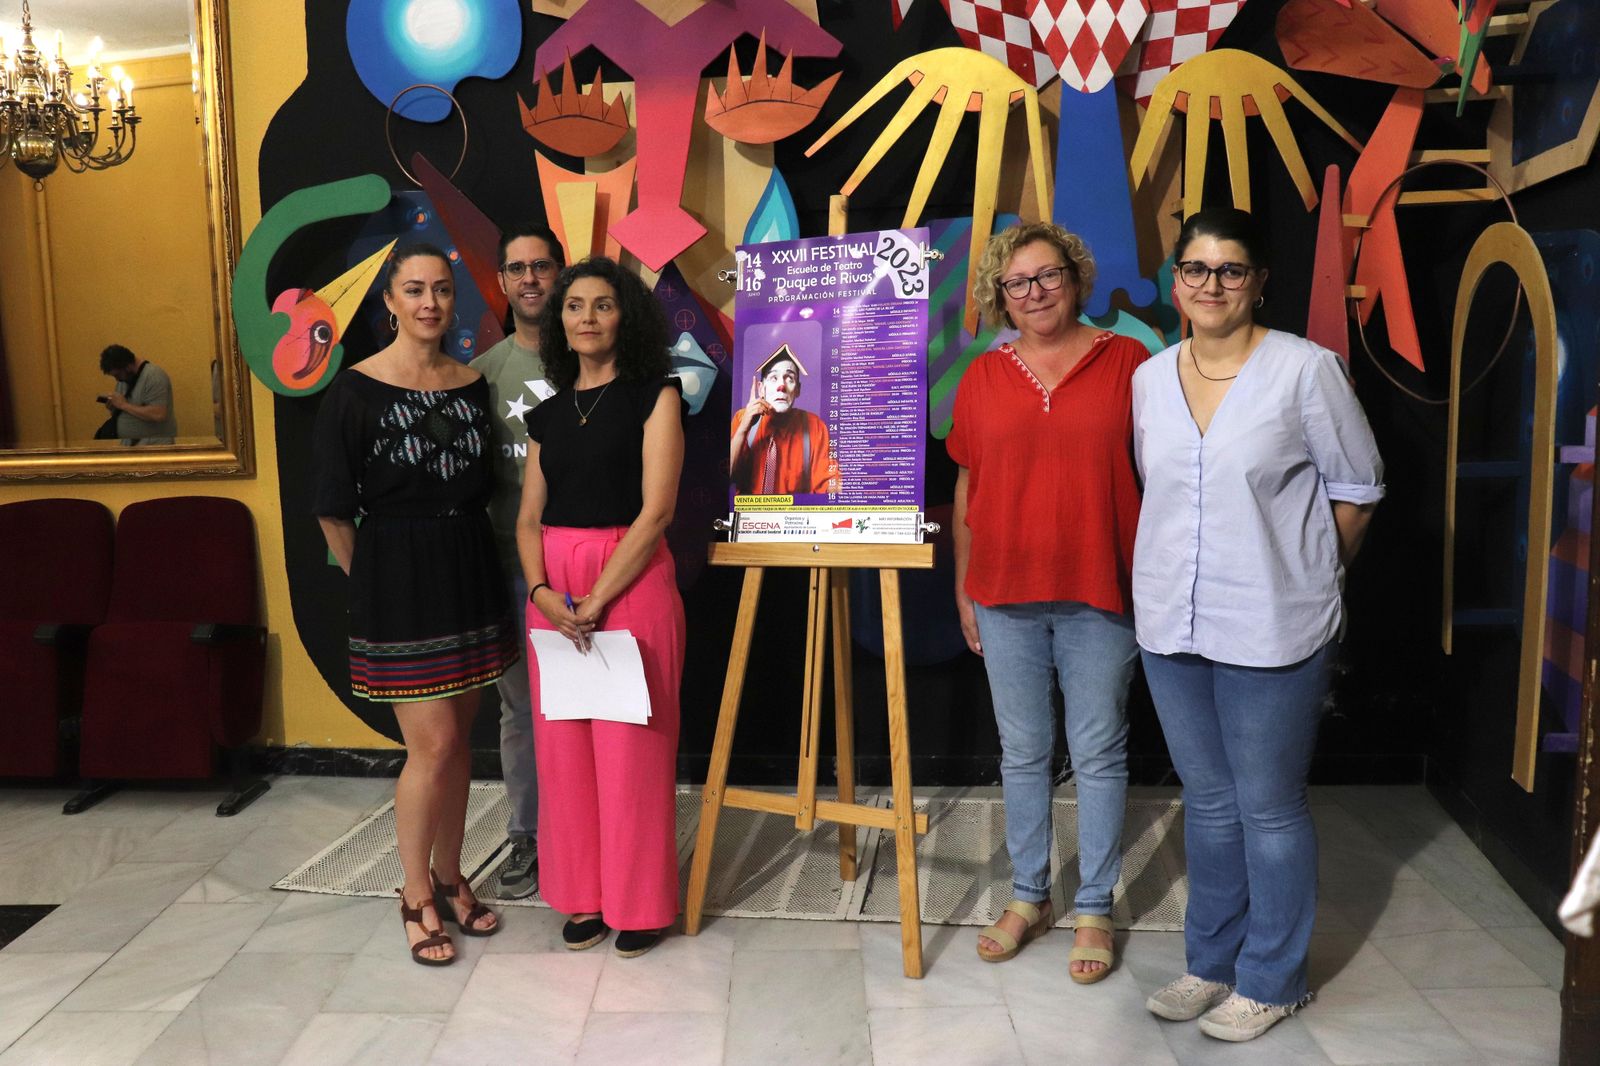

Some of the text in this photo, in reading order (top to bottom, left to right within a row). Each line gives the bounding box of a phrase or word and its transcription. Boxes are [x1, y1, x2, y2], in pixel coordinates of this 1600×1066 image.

[772, 242, 877, 264] XXVII FESTIVAL
[746, 252, 762, 268] 14
[787, 261, 863, 275] Escuela de Teatro
[877, 237, 924, 296] 2023
[745, 277, 762, 291] 16
[772, 276, 818, 291] "Duque
[820, 273, 836, 286] de
[768, 288, 877, 303] PROGRAMACIÓN FESTIVAL
[832, 327, 840, 335] 18
[830, 366, 839, 374] 20
[829, 410, 838, 418] 23
[828, 451, 838, 459] 26
[828, 464, 837, 472] 27
[736, 496, 754, 504] VENTA
[828, 492, 836, 500] 16
[742, 522, 781, 530] ESCENA
